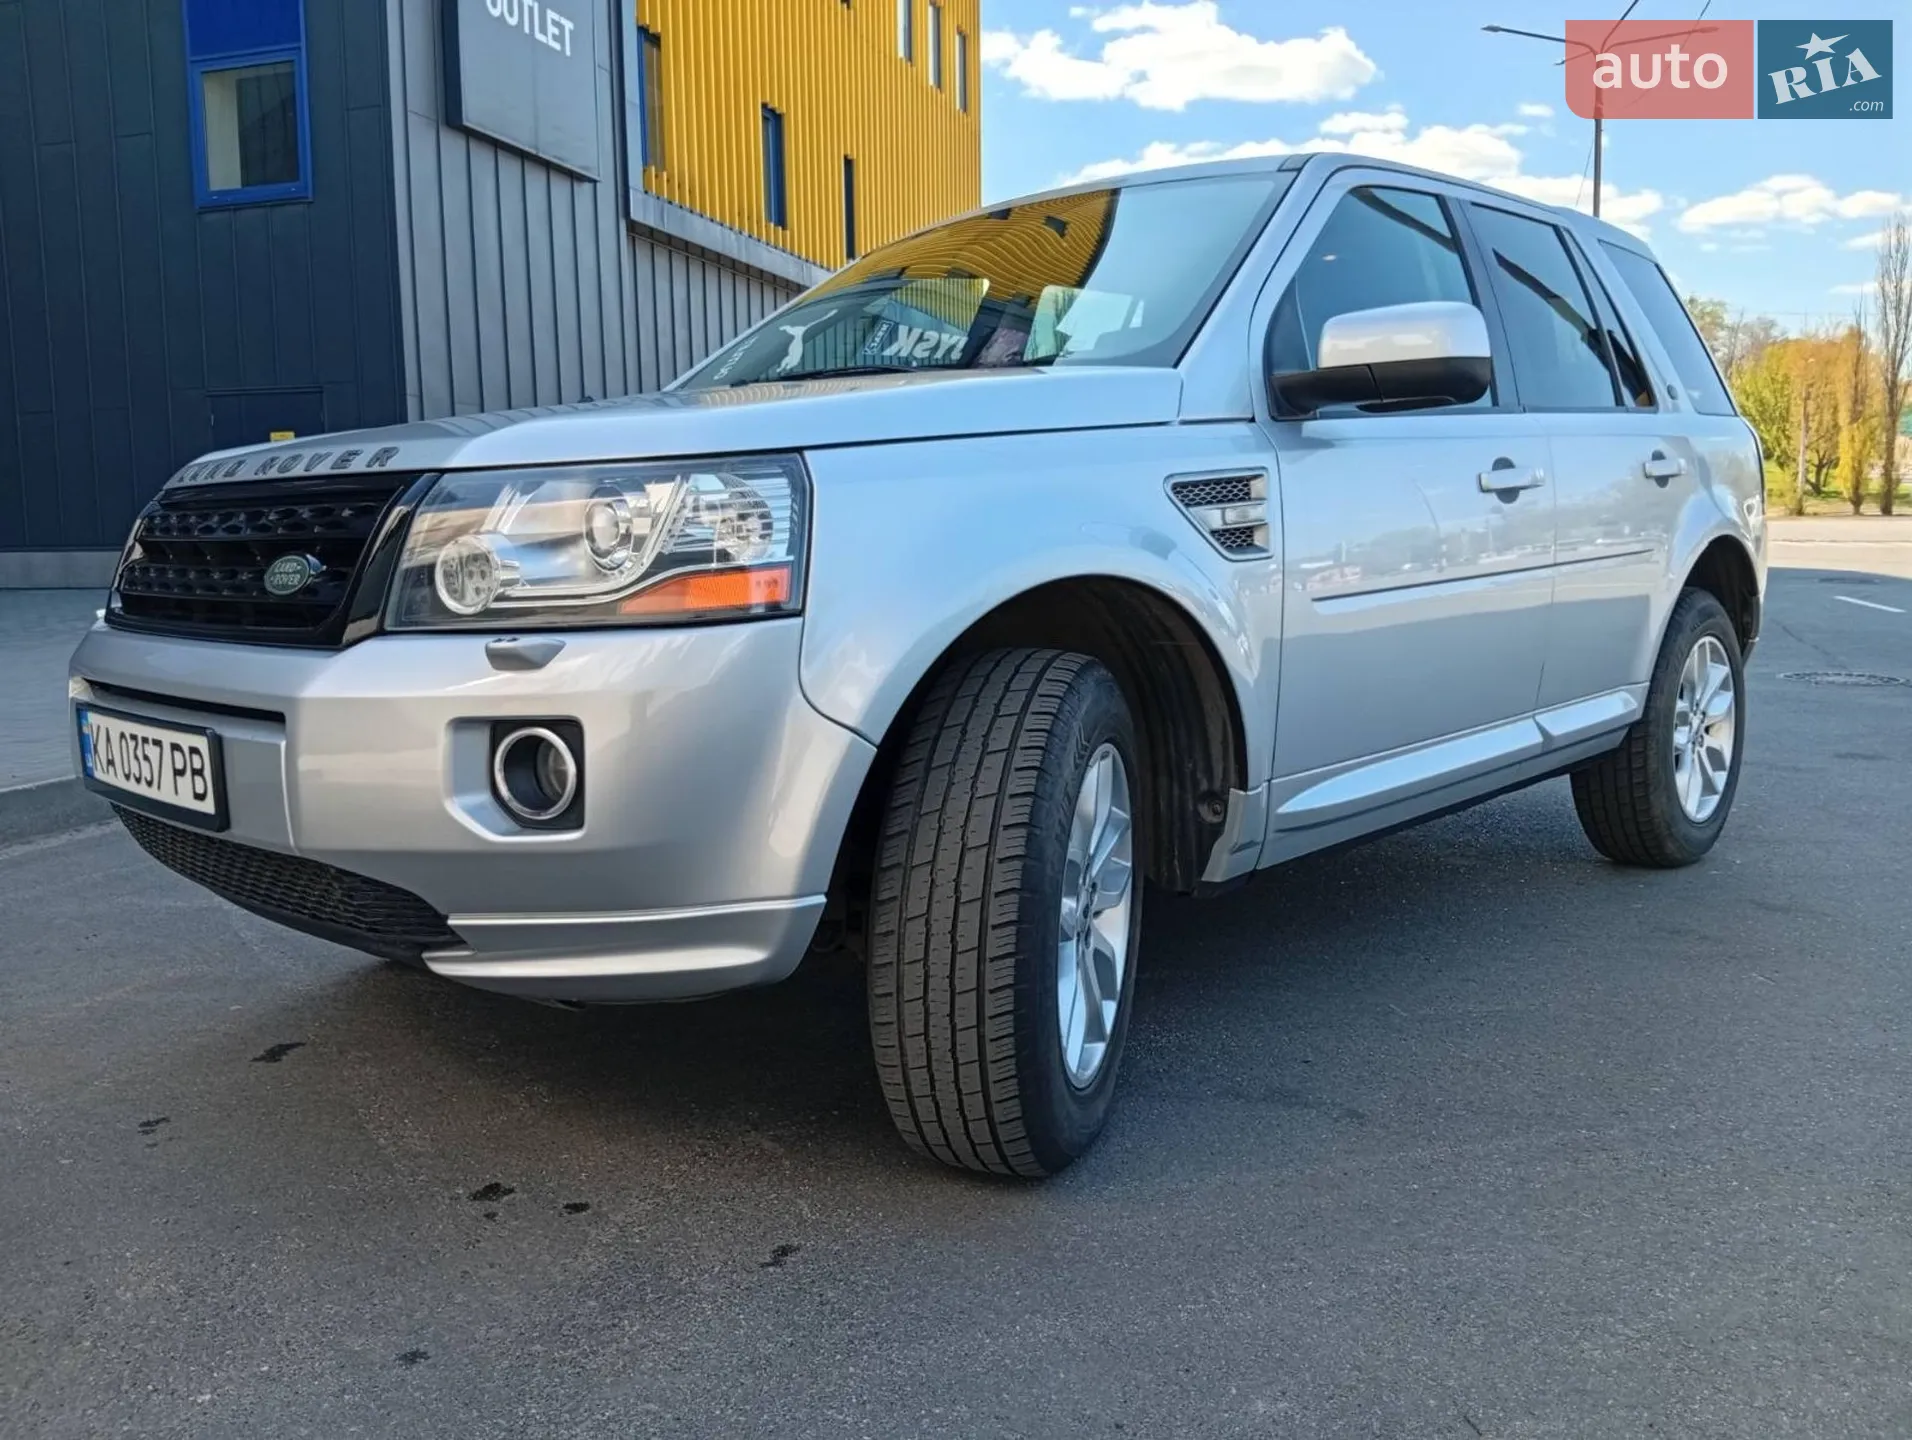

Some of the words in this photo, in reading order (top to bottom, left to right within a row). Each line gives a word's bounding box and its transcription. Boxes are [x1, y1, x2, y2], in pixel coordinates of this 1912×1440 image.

[254, 447, 399, 477] ROVER
[90, 723, 118, 779] KA
[119, 731, 163, 791] 0357
[170, 742, 208, 801] PB
